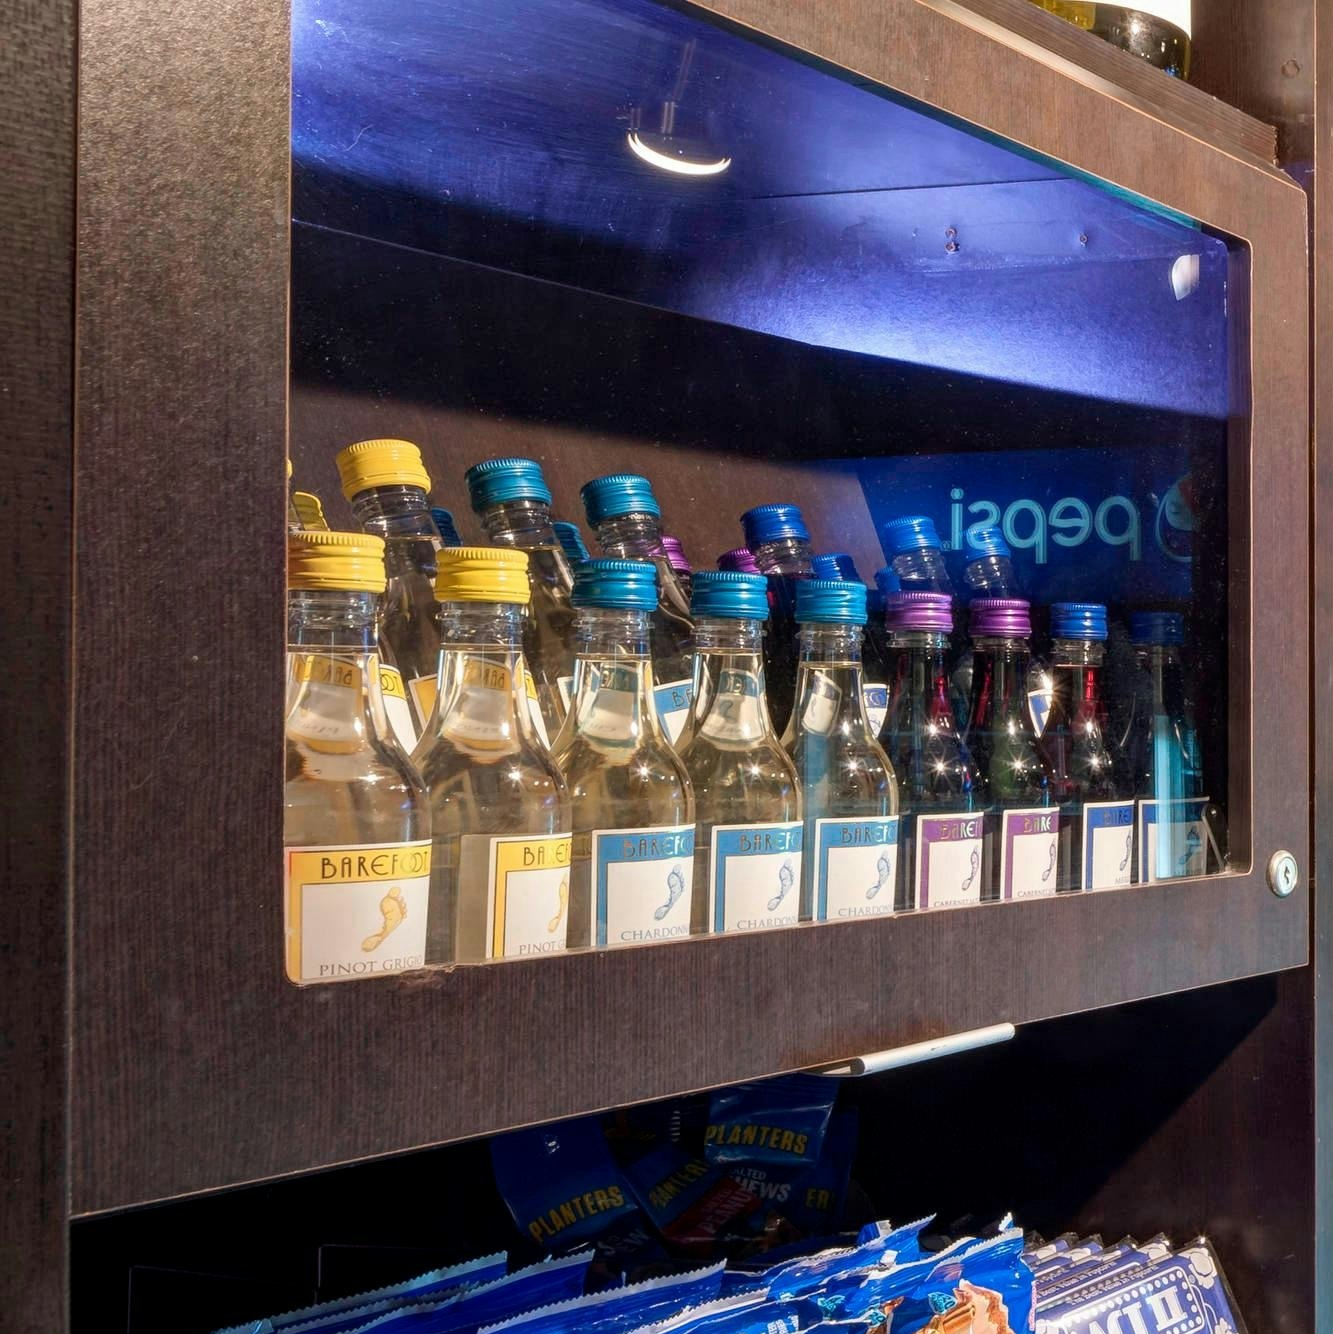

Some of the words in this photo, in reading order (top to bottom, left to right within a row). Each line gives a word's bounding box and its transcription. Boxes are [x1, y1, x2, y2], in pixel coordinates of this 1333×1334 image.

[320, 852, 429, 880] BAREFOOT
[519, 941, 554, 956] PINOT
[319, 961, 377, 977] PINOT
[704, 1124, 809, 1155] PLANTERS
[527, 1185, 626, 1245] PLANTERS
